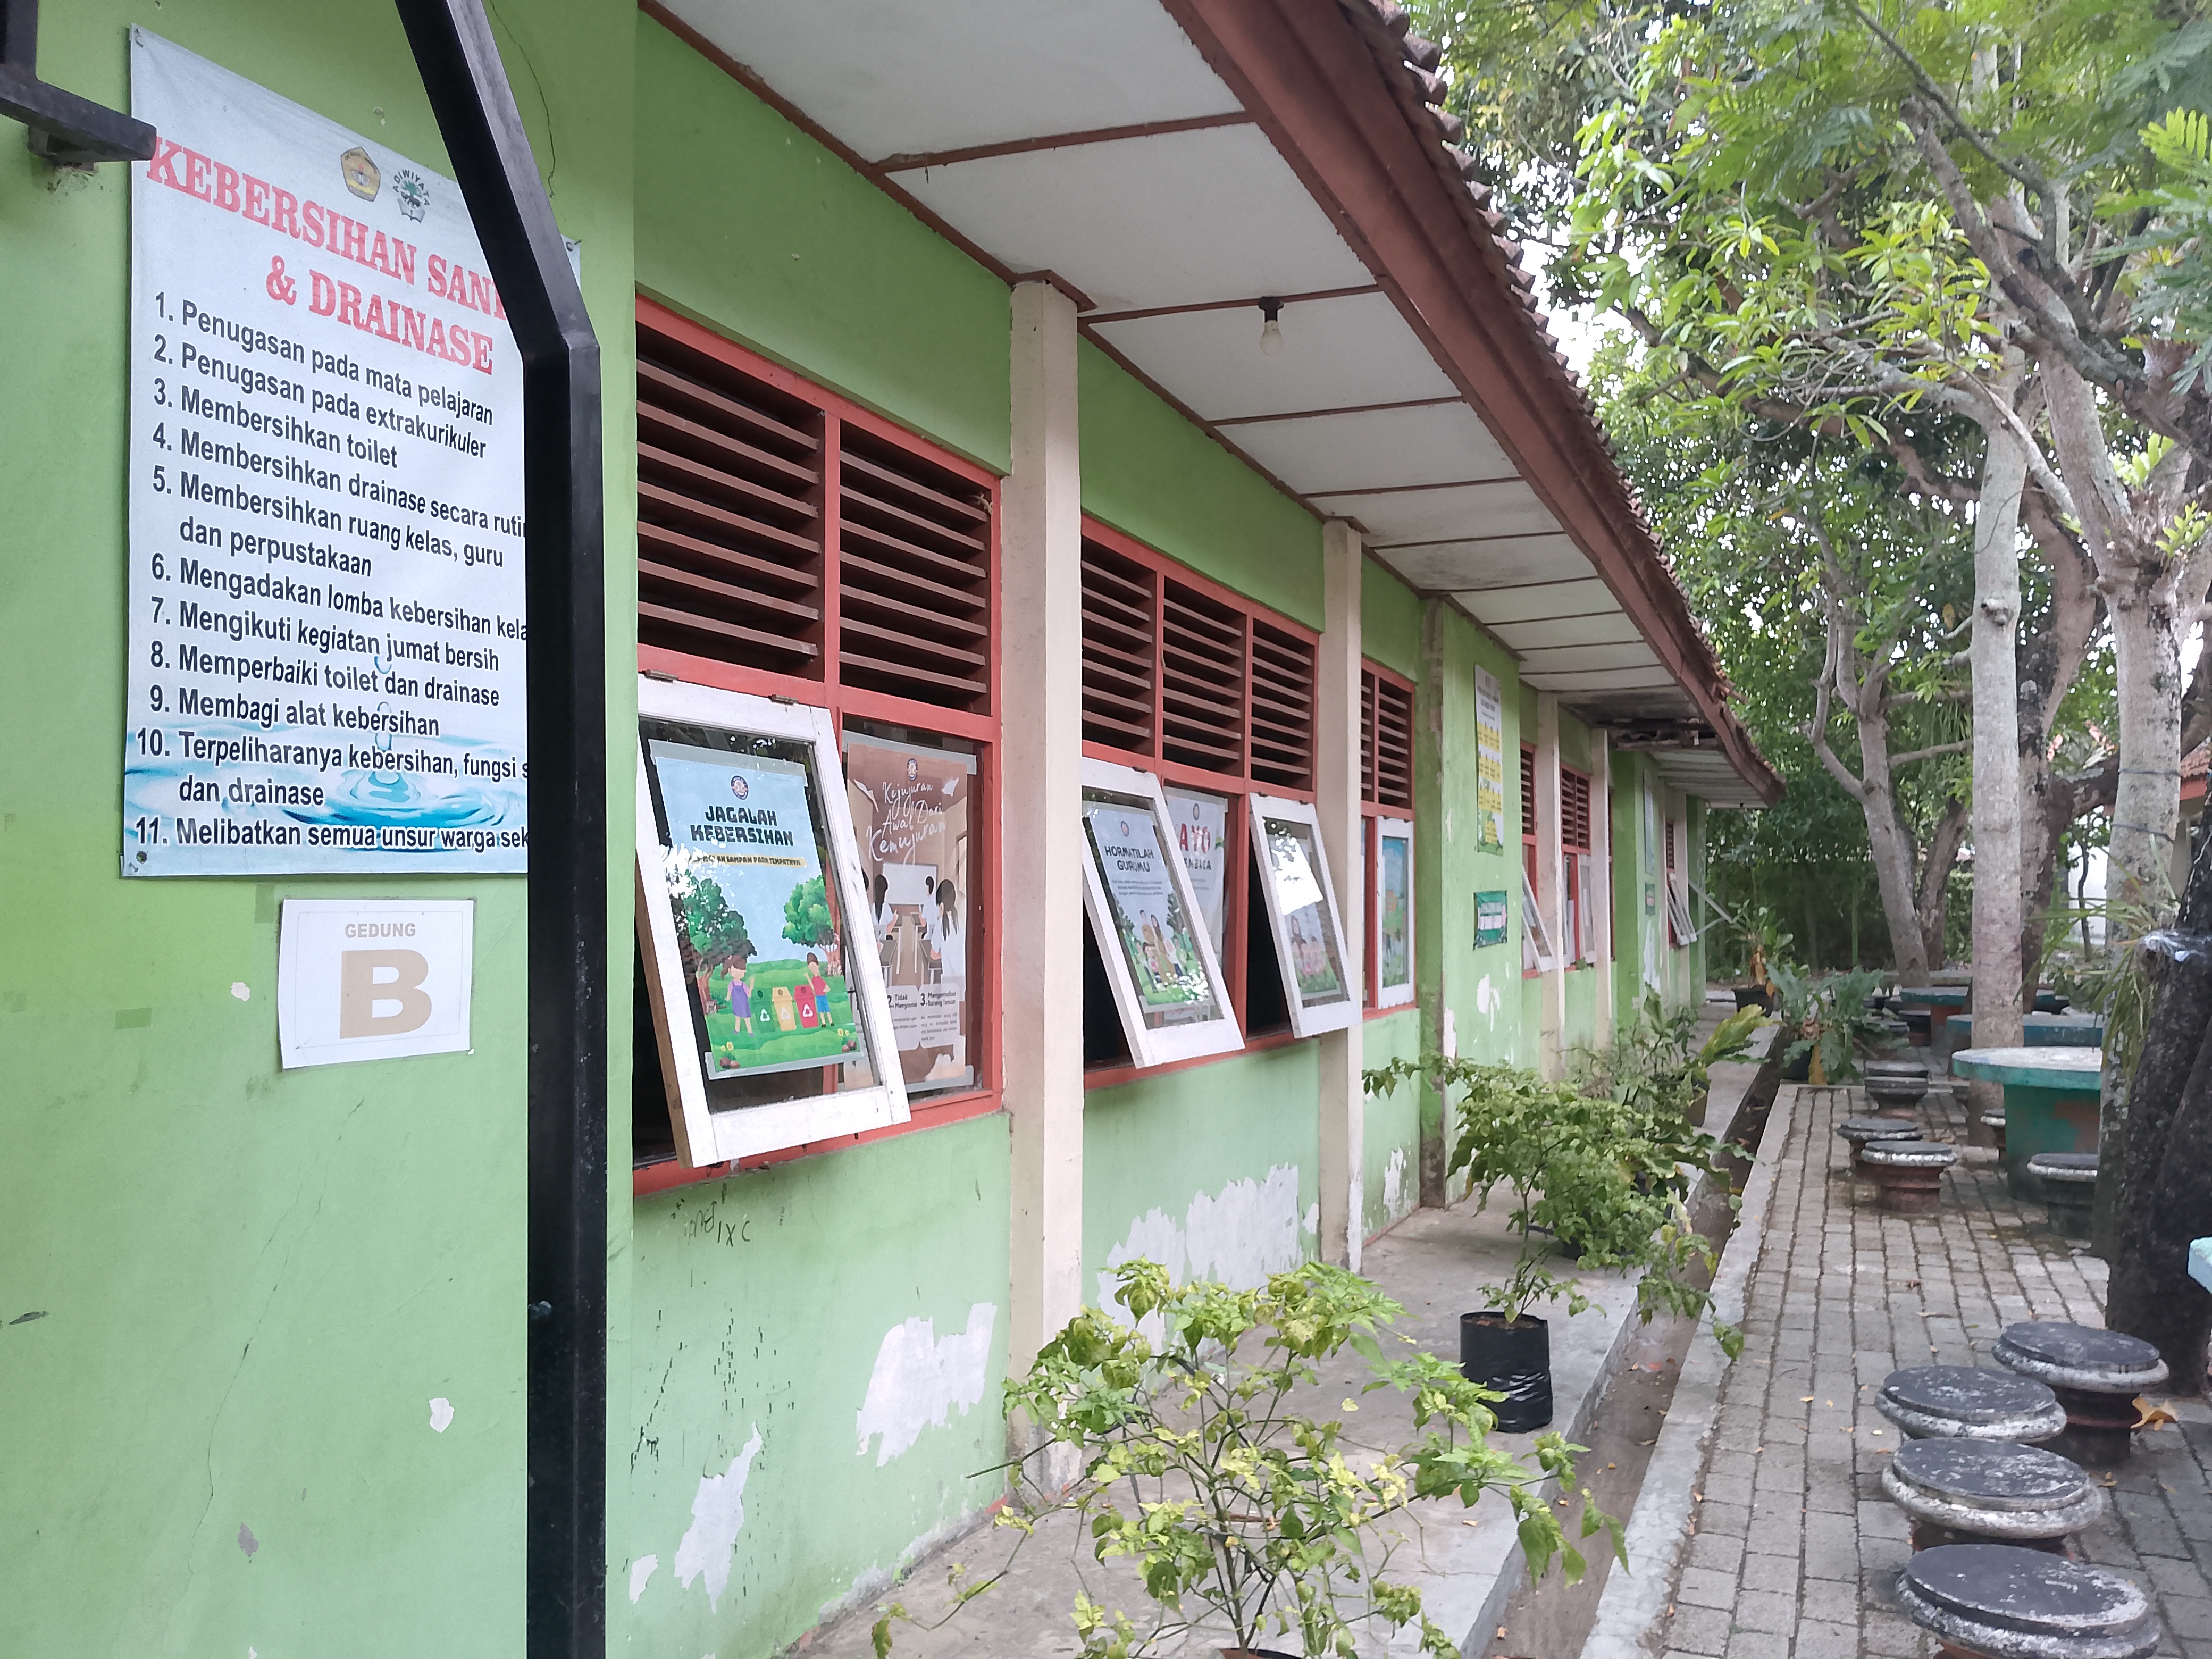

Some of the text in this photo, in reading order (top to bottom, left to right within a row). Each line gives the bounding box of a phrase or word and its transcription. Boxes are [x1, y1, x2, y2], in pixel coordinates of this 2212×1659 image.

[147, 136, 416, 285] KEBERSIHAN
[392, 169, 430, 205] ADIWIYATA
[266, 255, 492, 375] & DRAINASE
[156, 291, 492, 425] 1. Penugasan pada mata pelajaran
[154, 334, 486, 458] 2. Penugasan pada extrakurikuler
[154, 378, 397, 468] 3. Membersihkan toilet
[153, 422, 525, 538] 4. Membersihkan drainase secara ruti
[153, 465, 503, 567] 5. Membersihkan ruang kelas, guru
[180, 516, 371, 577] dan perpustakaan
[152, 553, 171, 581] 6.
[180, 557, 321, 606] Mengadakan
[328, 584, 383, 618] lomba
[390, 597, 491, 634] kebersihan
[151, 596, 499, 671] 7. Mengikuti kegiatan jumat bersih
[151, 640, 499, 706] 8. Memperbaiki toilet dan drainase
[150, 684, 439, 736] 9. Membagi alat kebersihan
[137, 727, 170, 757] 10.
[179, 731, 342, 773] Terpeliharanya
[349, 744, 458, 778] kebersihan,
[463, 753, 516, 783] fungsi
[179, 775, 324, 805] dan drainase
[705, 806, 777, 826] JAGALAH
[882, 781, 933, 820] Kejujuran
[882, 799, 943, 839] Awal Dari
[136, 817, 168, 844] 11.
[177, 817, 301, 845] Melibatkan
[308, 825, 375, 847] semua
[382, 827, 436, 847] unsur
[441, 830, 496, 853] warga
[690, 824, 794, 847] KEBERSIHAN
[1104, 845, 1154, 859] HORMATILAH
[1180, 823, 1210, 854] AYO
[345, 923, 416, 939] GEDUNG
[340, 949, 432, 1040] B
